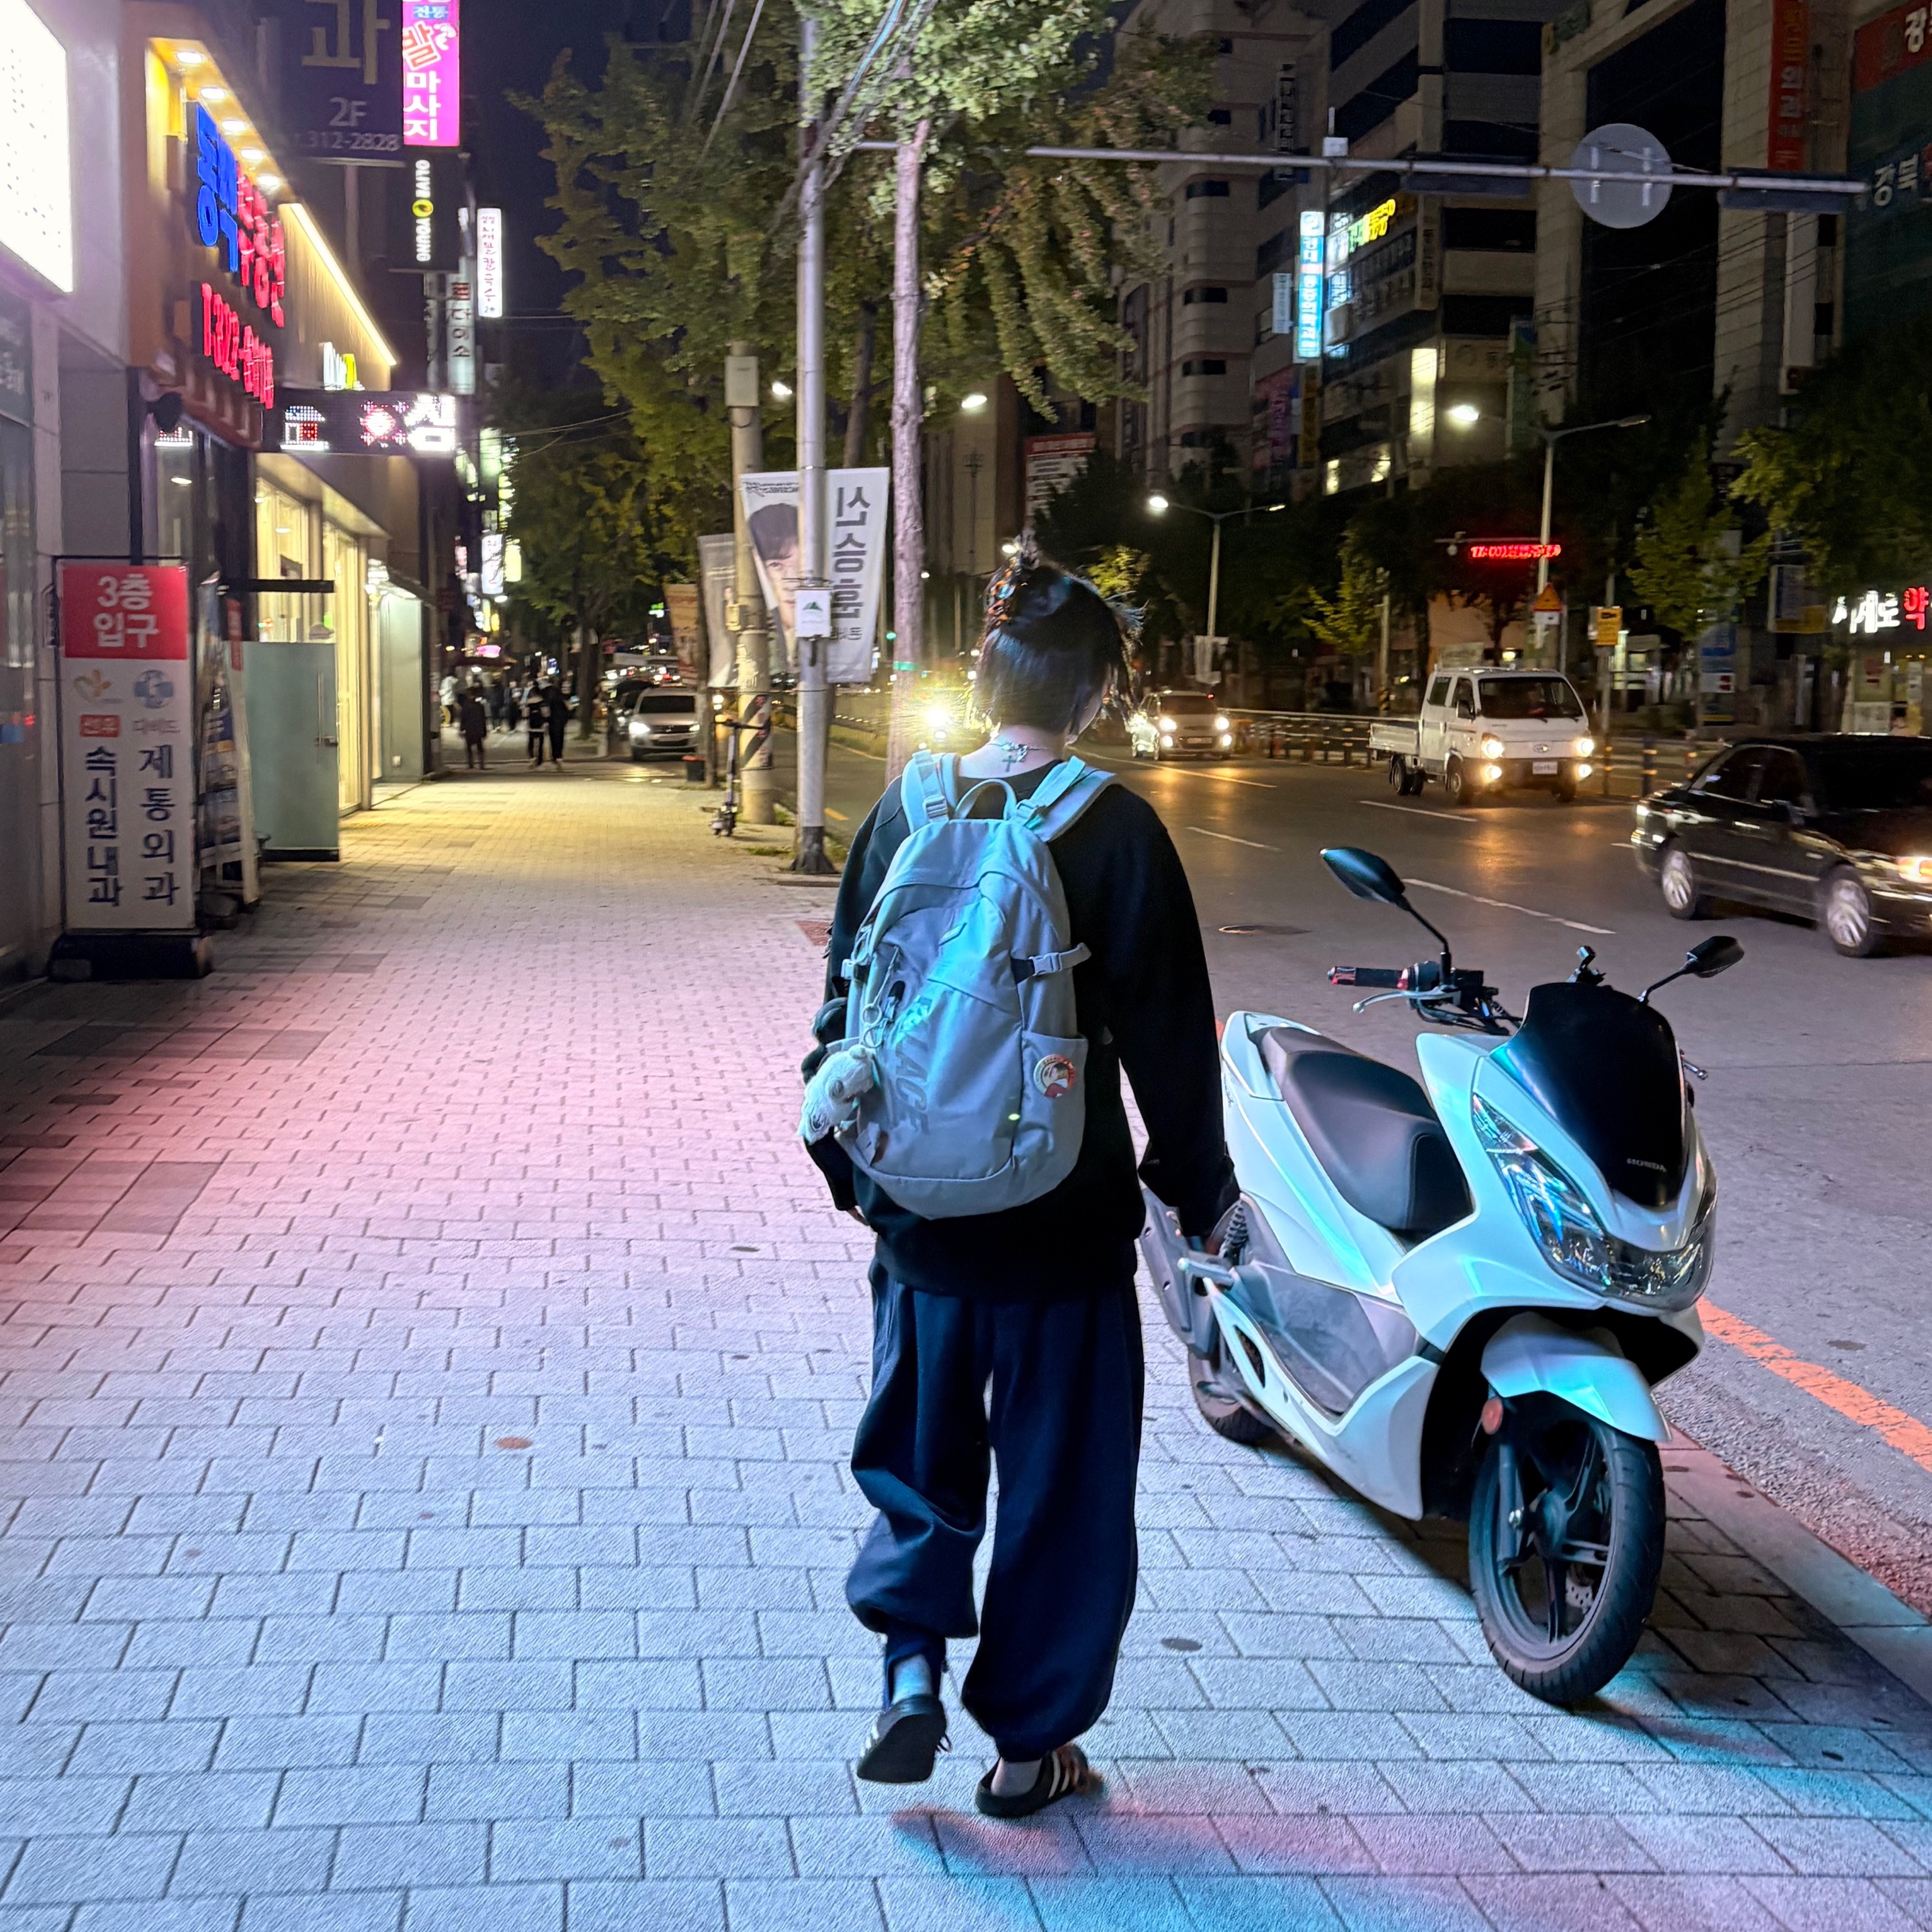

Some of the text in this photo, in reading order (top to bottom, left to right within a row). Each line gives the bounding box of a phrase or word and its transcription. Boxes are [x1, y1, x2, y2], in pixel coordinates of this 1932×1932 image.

[328, 96, 367, 127] 2F
[415, 159, 431, 262] OLIVE YOUNG
[98, 574, 152, 611] 3층
[94, 612, 159, 649] 입구
[86, 745, 123, 907] 속시원내과
[139, 745, 179, 906] 제통외과
[1627, 1158, 1667, 1173] HONDA
